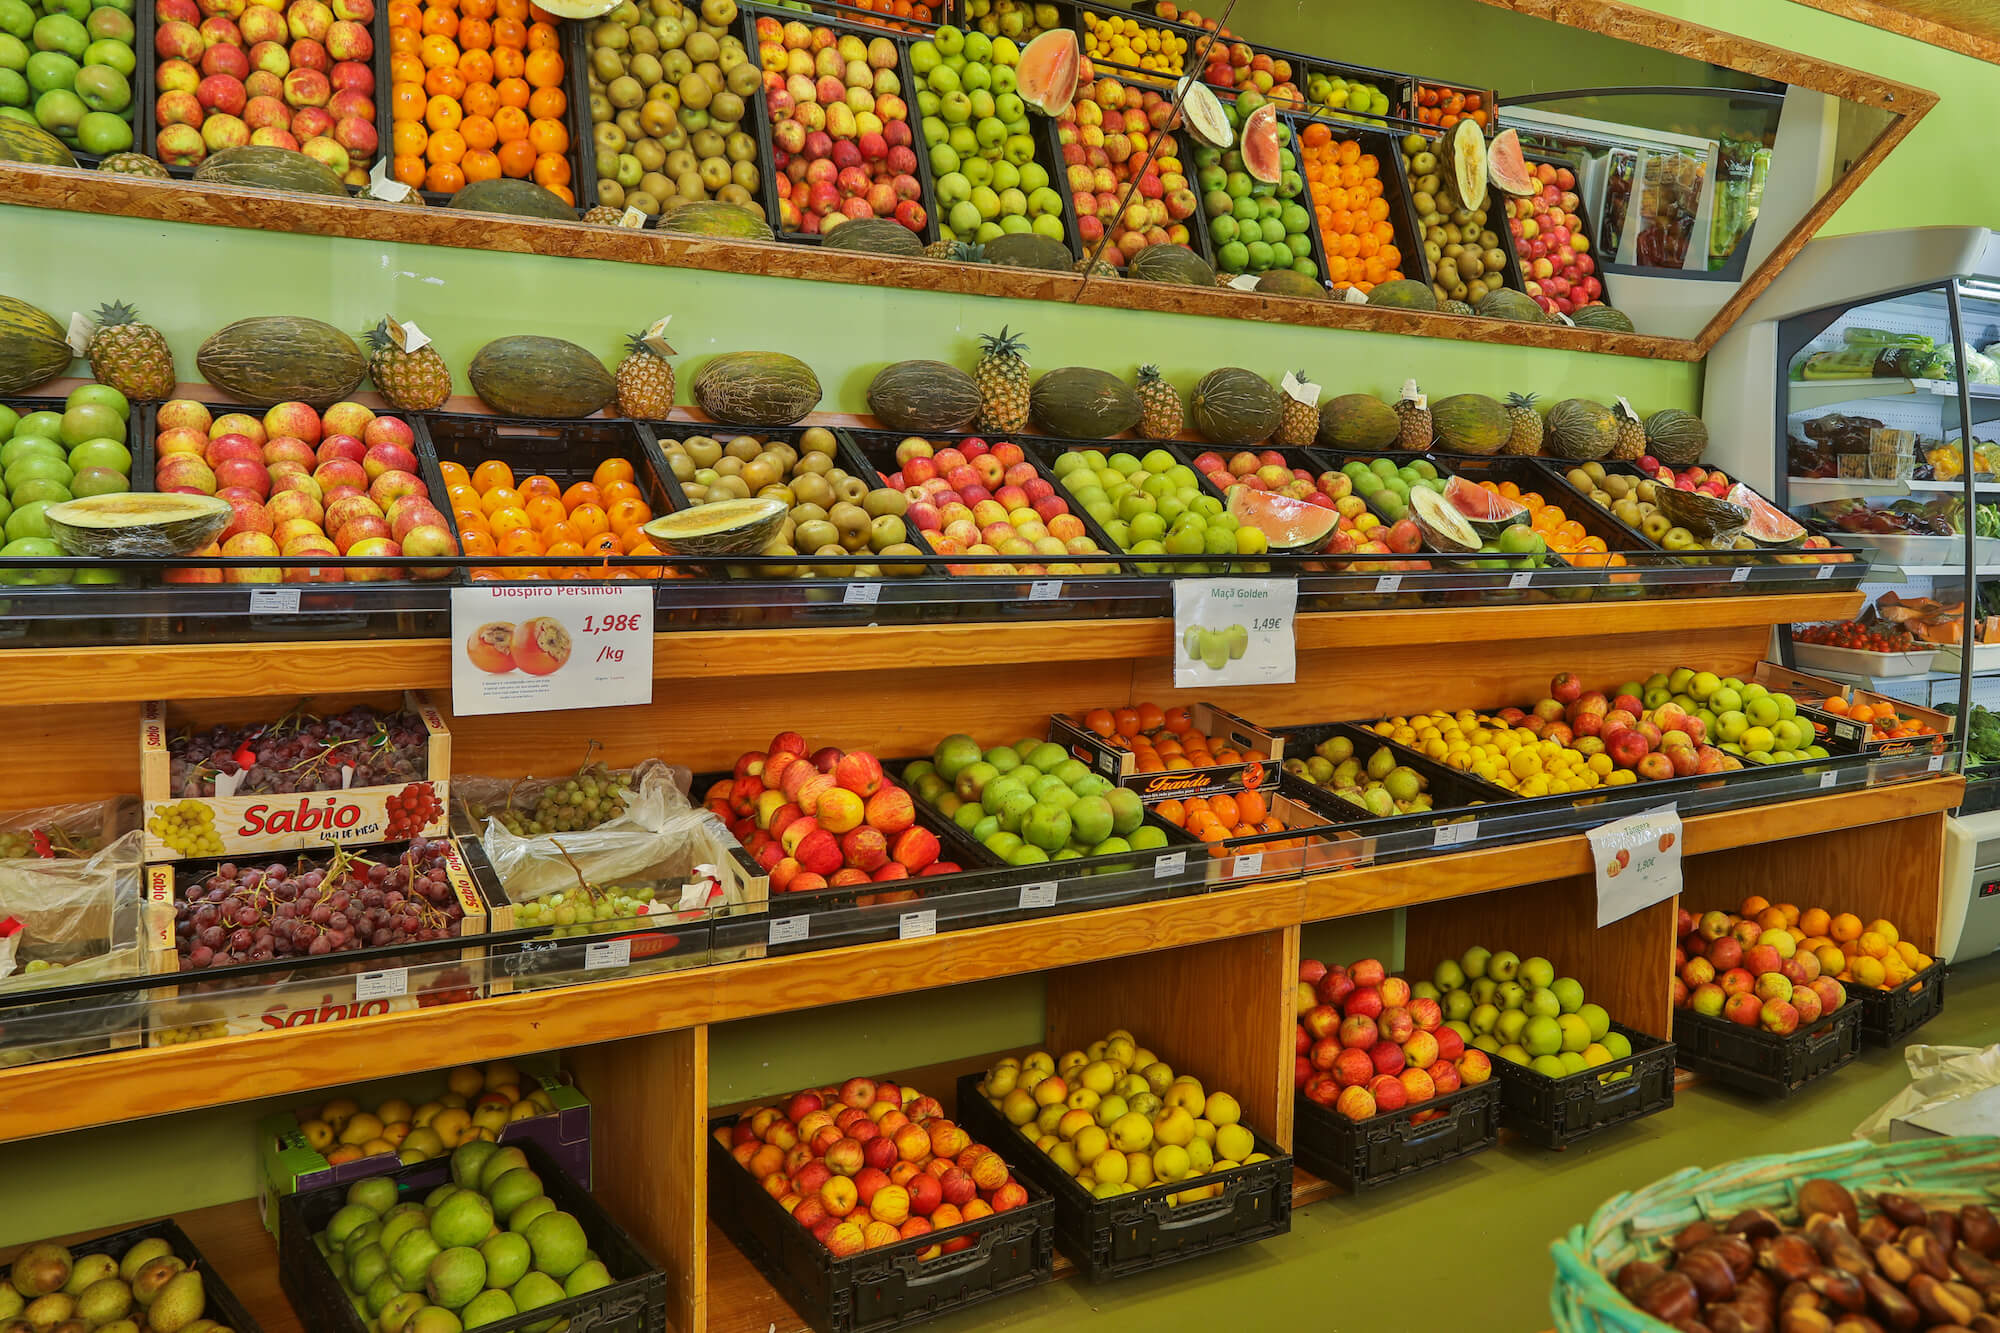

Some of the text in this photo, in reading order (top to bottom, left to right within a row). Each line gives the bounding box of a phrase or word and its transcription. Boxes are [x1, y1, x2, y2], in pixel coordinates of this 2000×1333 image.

[491, 586, 552, 599] Diospiro
[1211, 588, 1268, 600] Maçã Golden
[582, 614, 641, 635] 1,98€
[1252, 618, 1282, 630] 1,49€
[596, 646, 624, 662] /kg
[238, 796, 361, 837] Sabio
[152, 872, 167, 901] Sabio
[458, 879, 479, 908] Sabio
